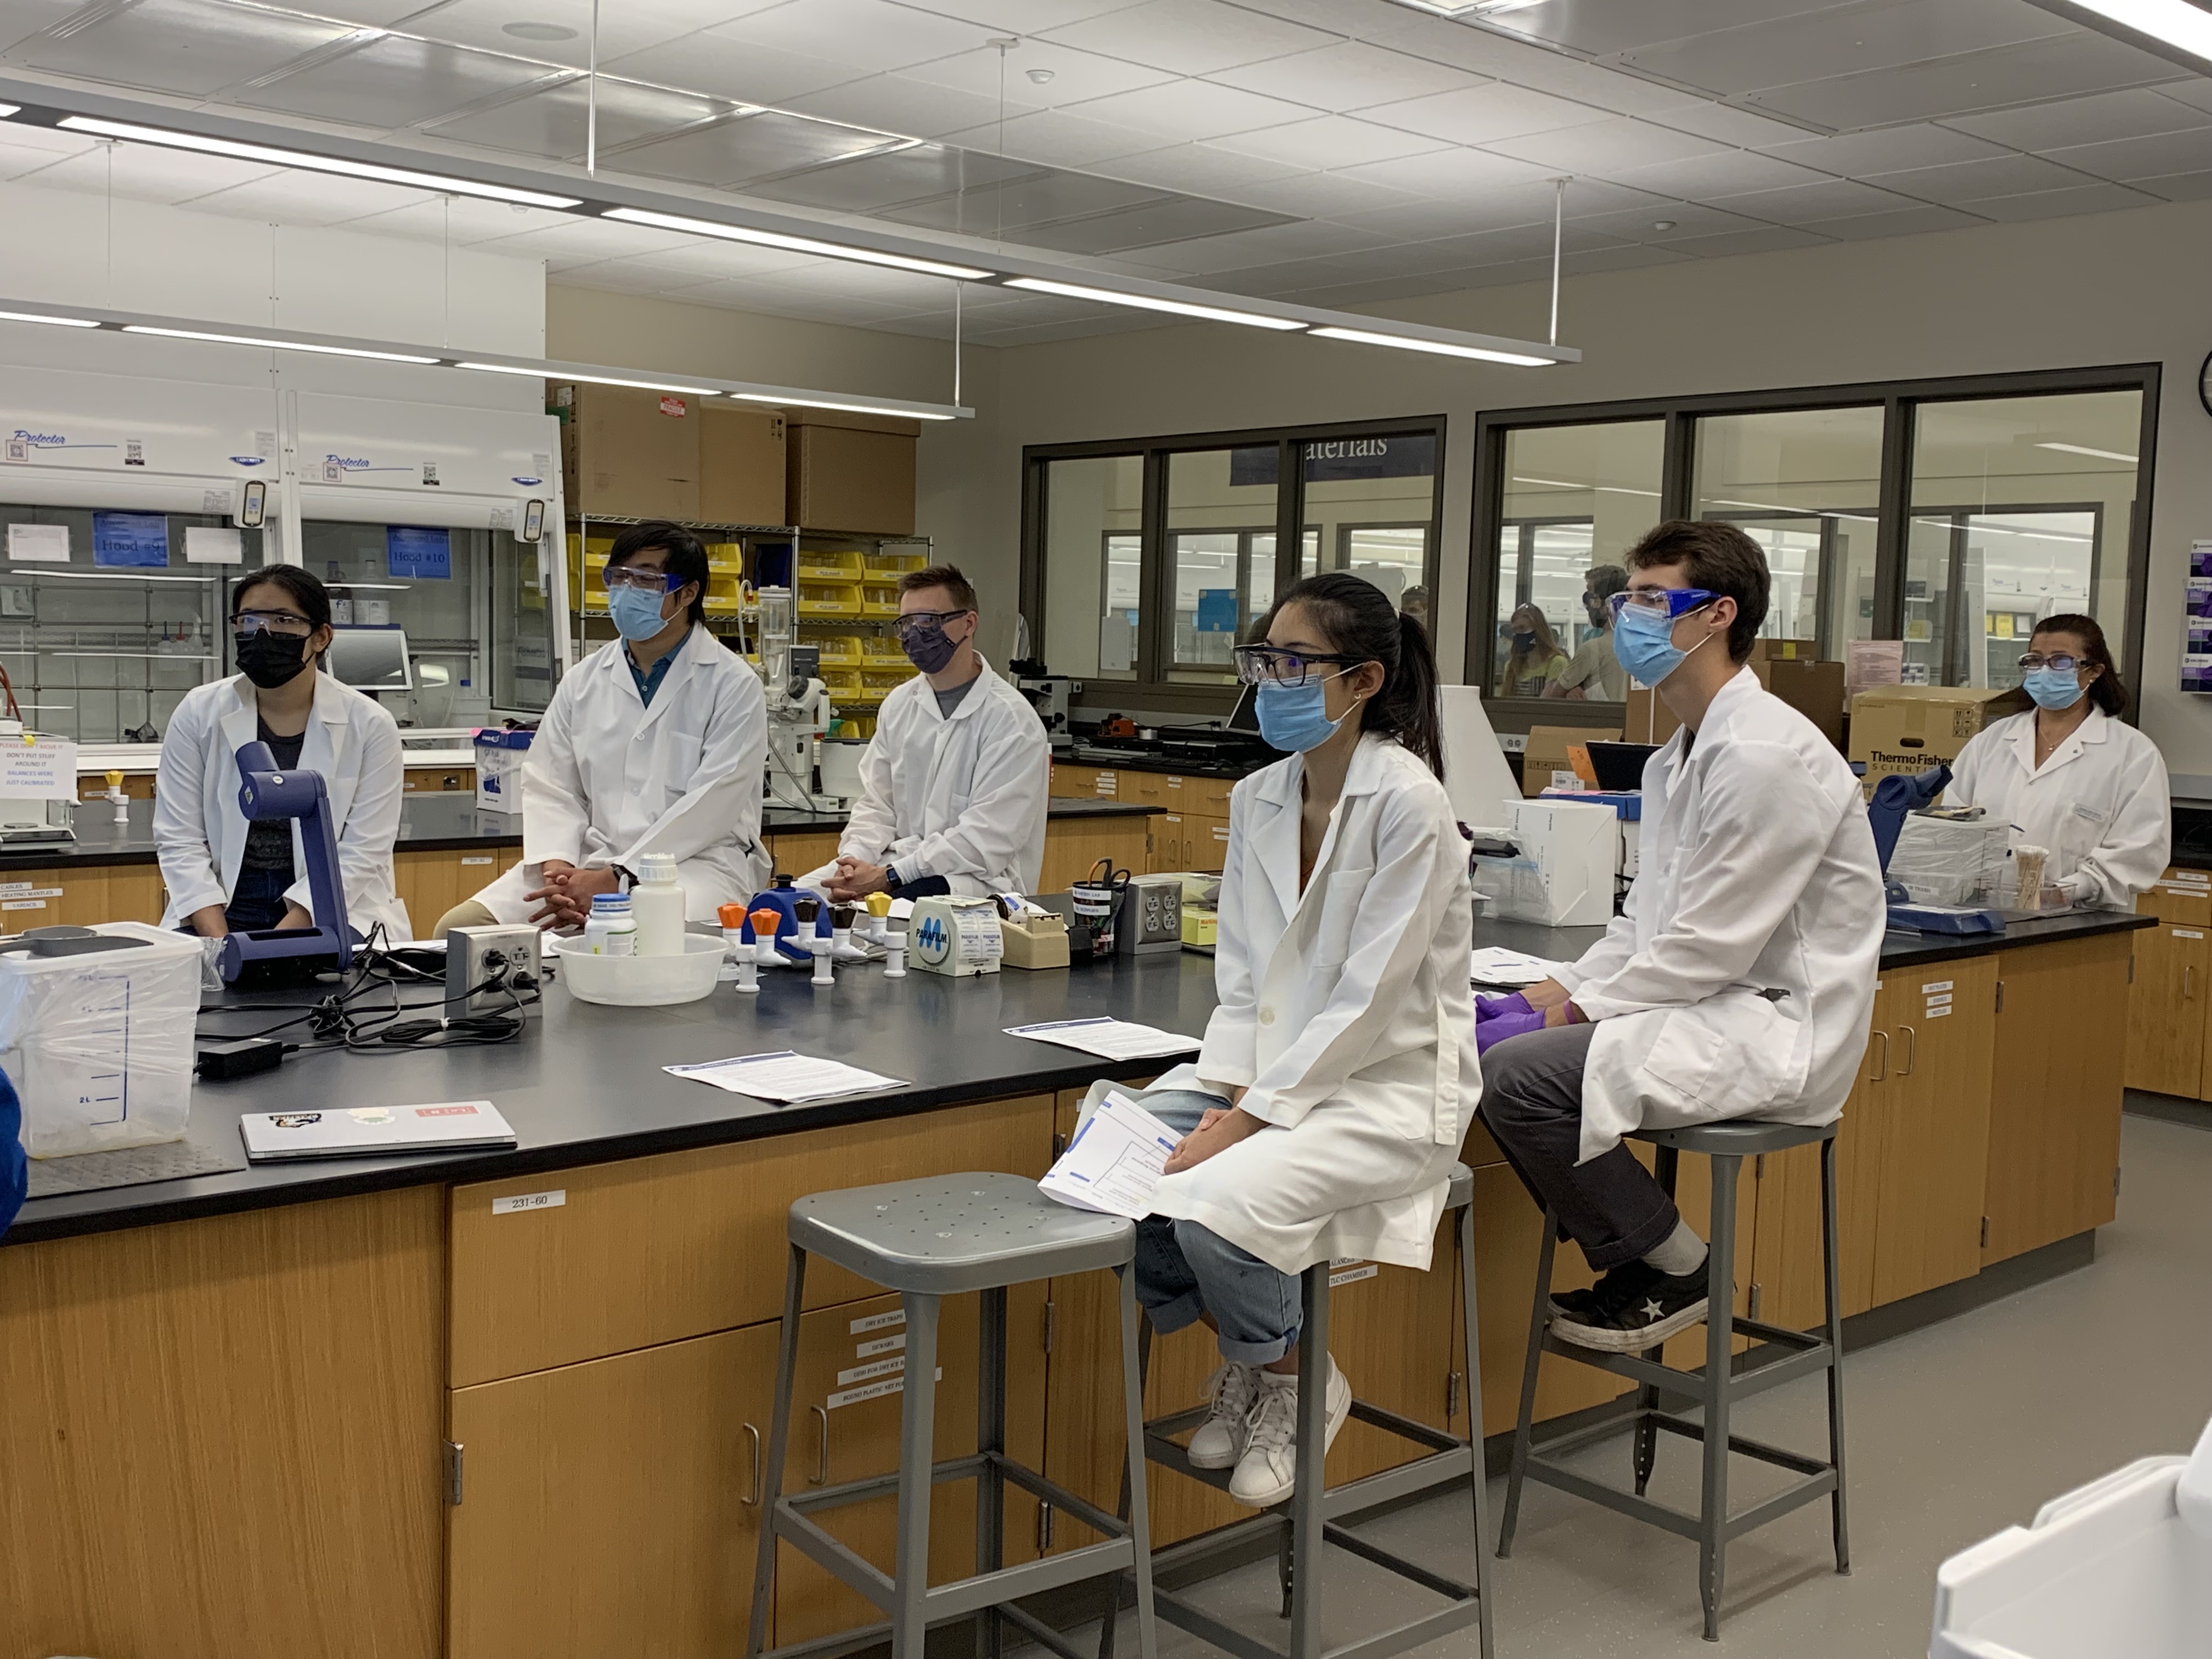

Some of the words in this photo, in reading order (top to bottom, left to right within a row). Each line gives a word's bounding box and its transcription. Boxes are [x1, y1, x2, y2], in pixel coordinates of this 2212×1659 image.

[14, 431, 65, 444] Protector
[1306, 439, 1387, 460] aterials
[326, 454, 369, 467] Protector
[102, 540, 138, 551] Hood
[144, 541, 160, 551] #9
[394, 552, 421, 562] Hood
[426, 553, 445, 563] #10
[916, 928, 947, 944] PARAFILM
[512, 1196, 548, 1208] 231-60
[1330, 1276, 1340, 1284] TLC
[1341, 1269, 1368, 1282] CHAMBER
[887, 1314, 903, 1323] TRAPS
[872, 1341, 894, 1351] DEWARS
[863, 1387, 884, 1396] PLASTIC
